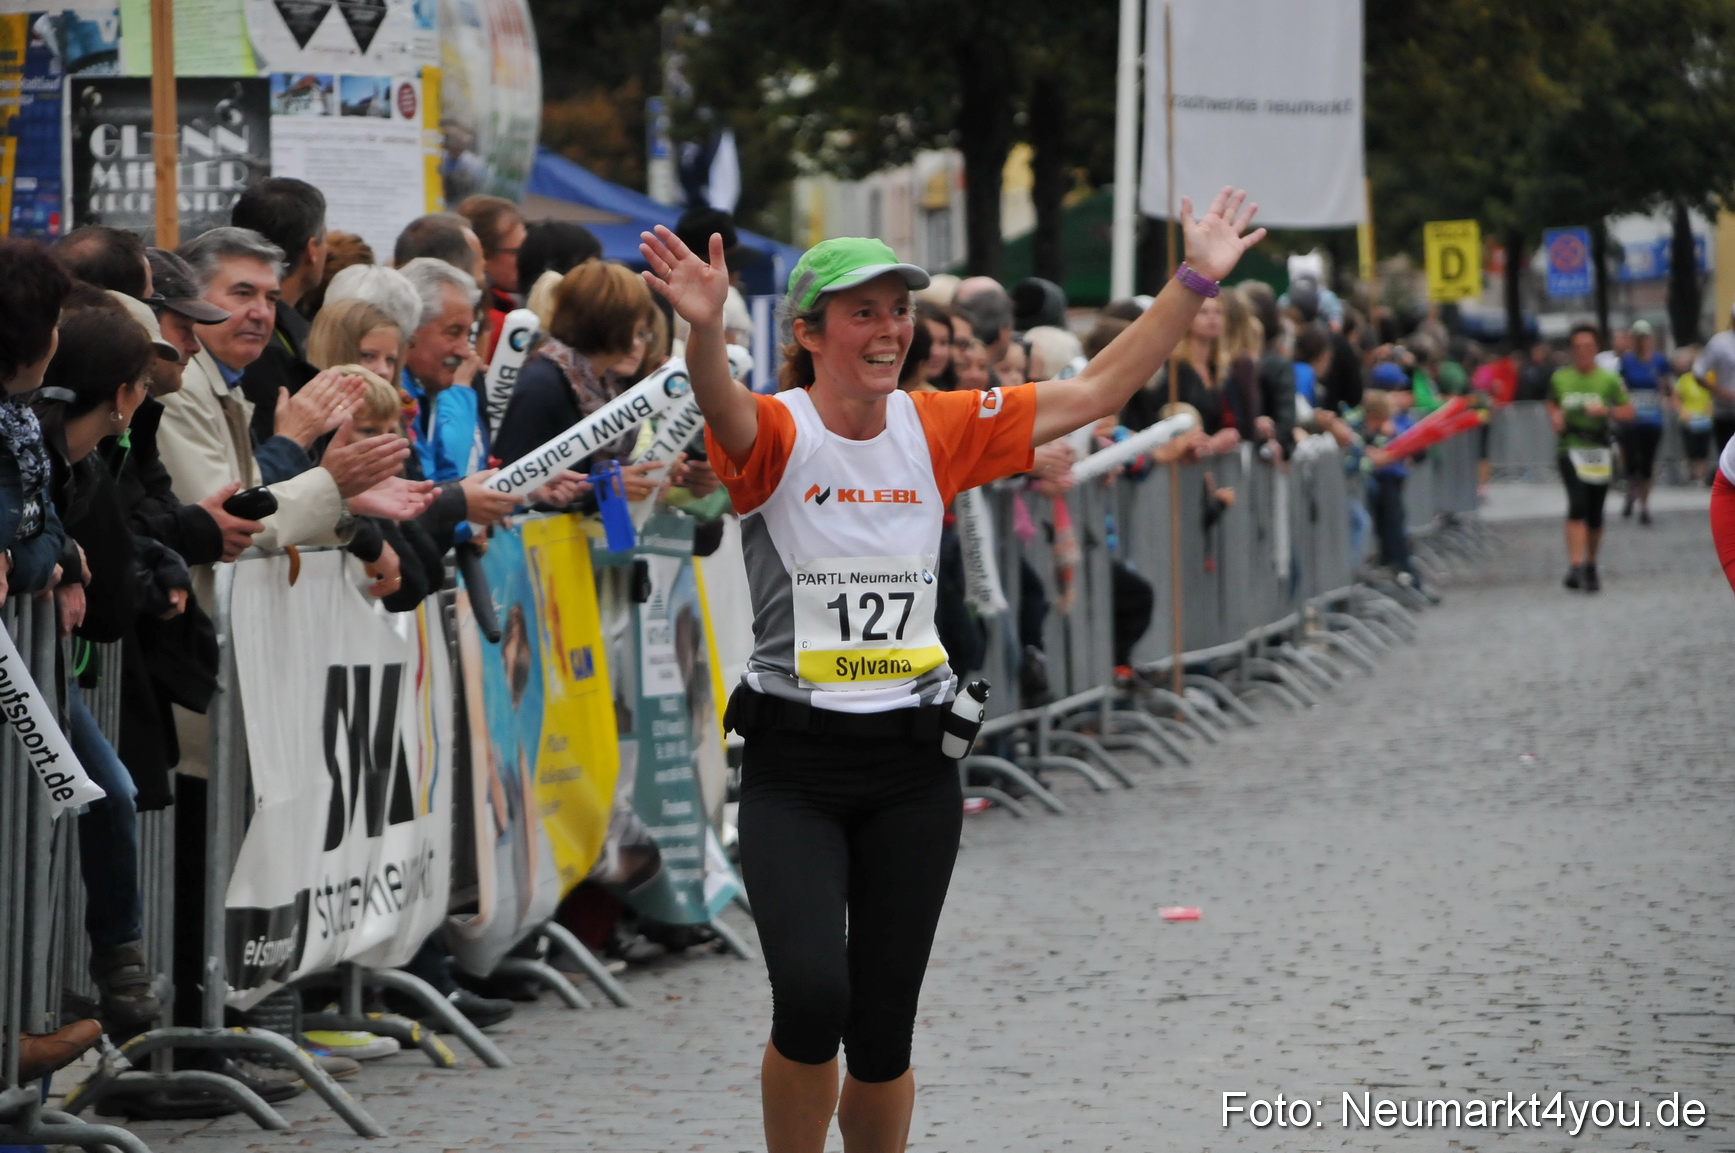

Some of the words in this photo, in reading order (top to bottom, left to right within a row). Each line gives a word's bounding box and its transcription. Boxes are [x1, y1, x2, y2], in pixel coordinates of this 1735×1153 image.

[89, 123, 249, 160] GLNN
[1440, 247, 1465, 281] D
[592, 395, 653, 443] BMW
[490, 430, 592, 494] Laufspo
[837, 488, 923, 505] KLEBL
[796, 572, 846, 586] PARTL
[850, 571, 918, 584] Neumarkt
[826, 591, 916, 642] 127
[801, 640, 809, 649] C
[835, 656, 913, 681] Sylvana
